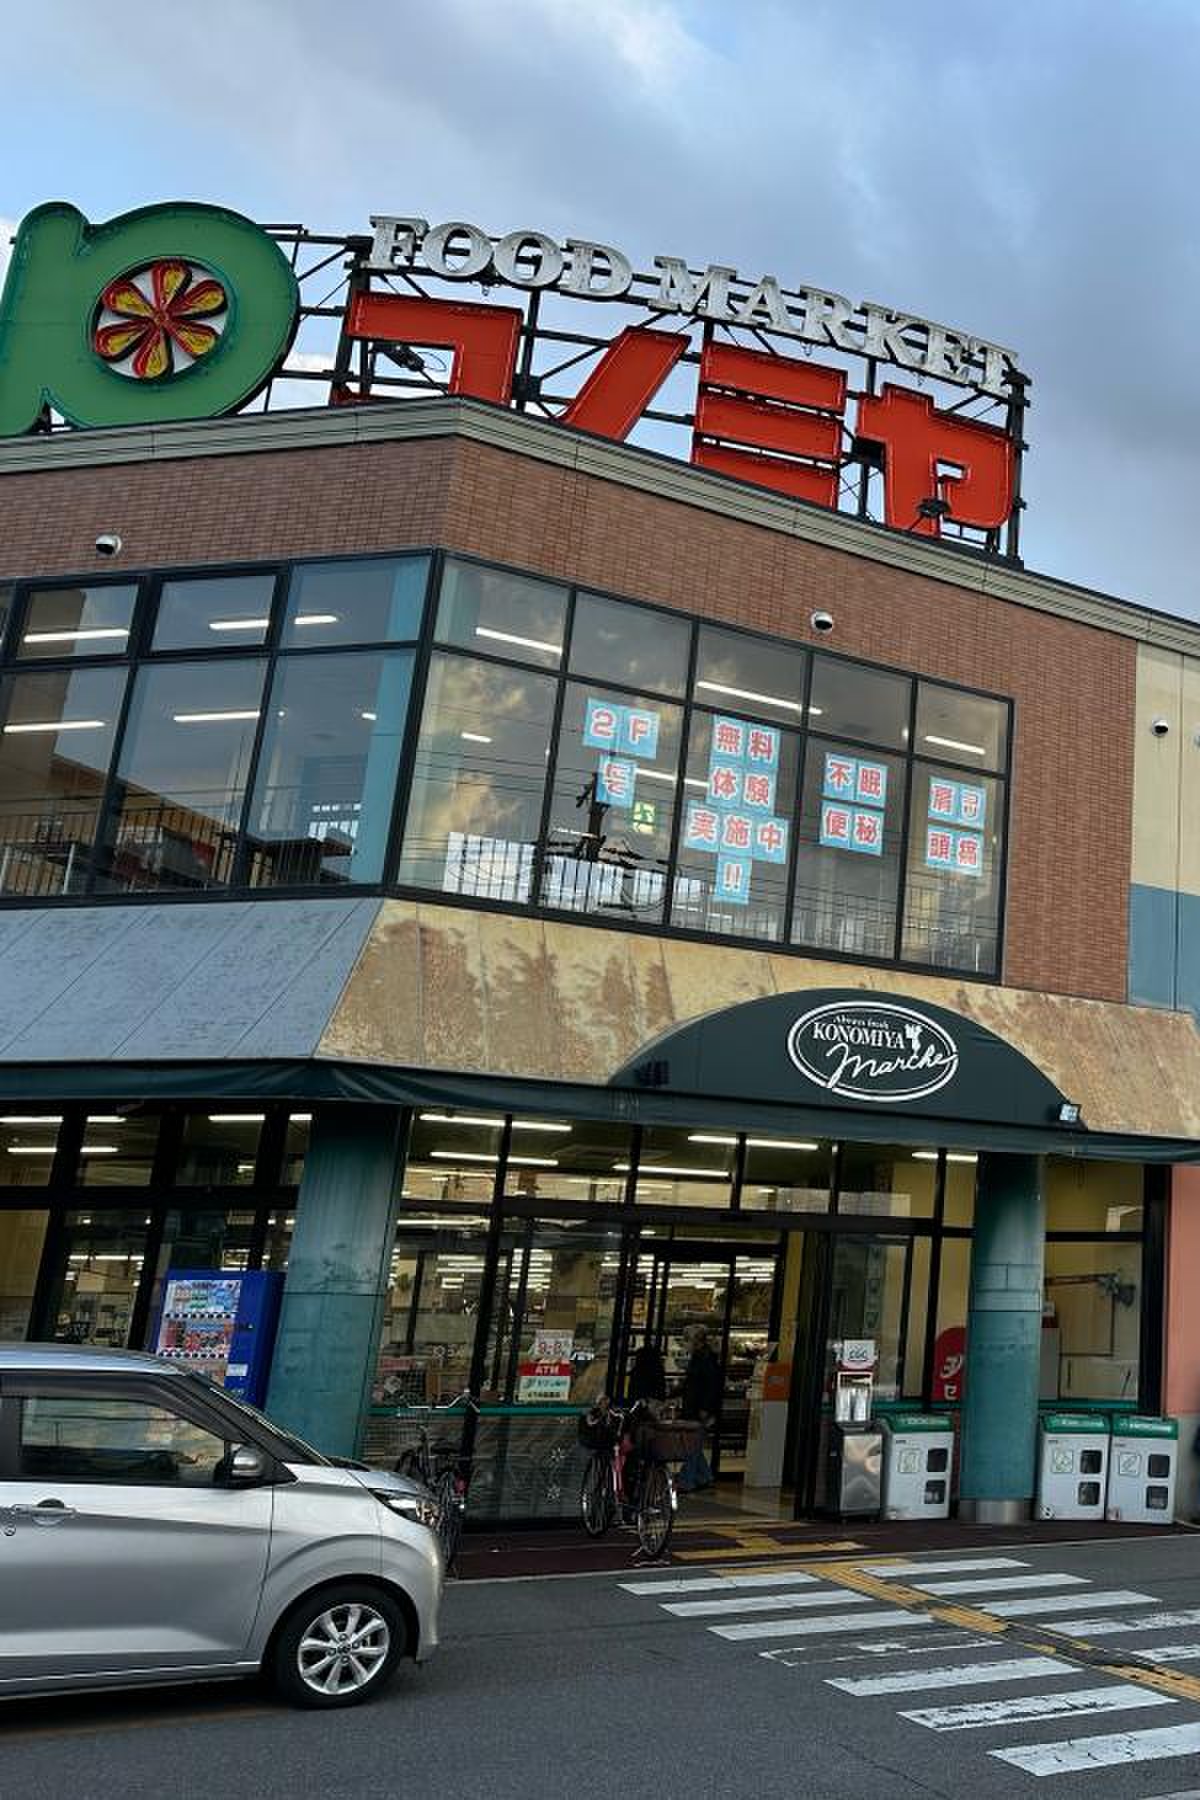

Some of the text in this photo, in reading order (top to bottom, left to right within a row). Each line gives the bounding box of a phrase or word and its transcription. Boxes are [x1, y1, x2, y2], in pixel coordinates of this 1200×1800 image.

[363, 215, 1019, 396] FOOD MARKET
[331, 289, 1014, 537] コノミヤ
[591, 708, 650, 745] 2F
[715, 723, 773, 764] 無料
[711, 767, 770, 806] 体験
[829, 761, 882, 798] 不眠
[689, 809, 783, 851] 実施中
[826, 808, 878, 844] 便秘
[929, 832, 977, 867] 頭痛
[813, 1021, 904, 1050] KONOMIYA
